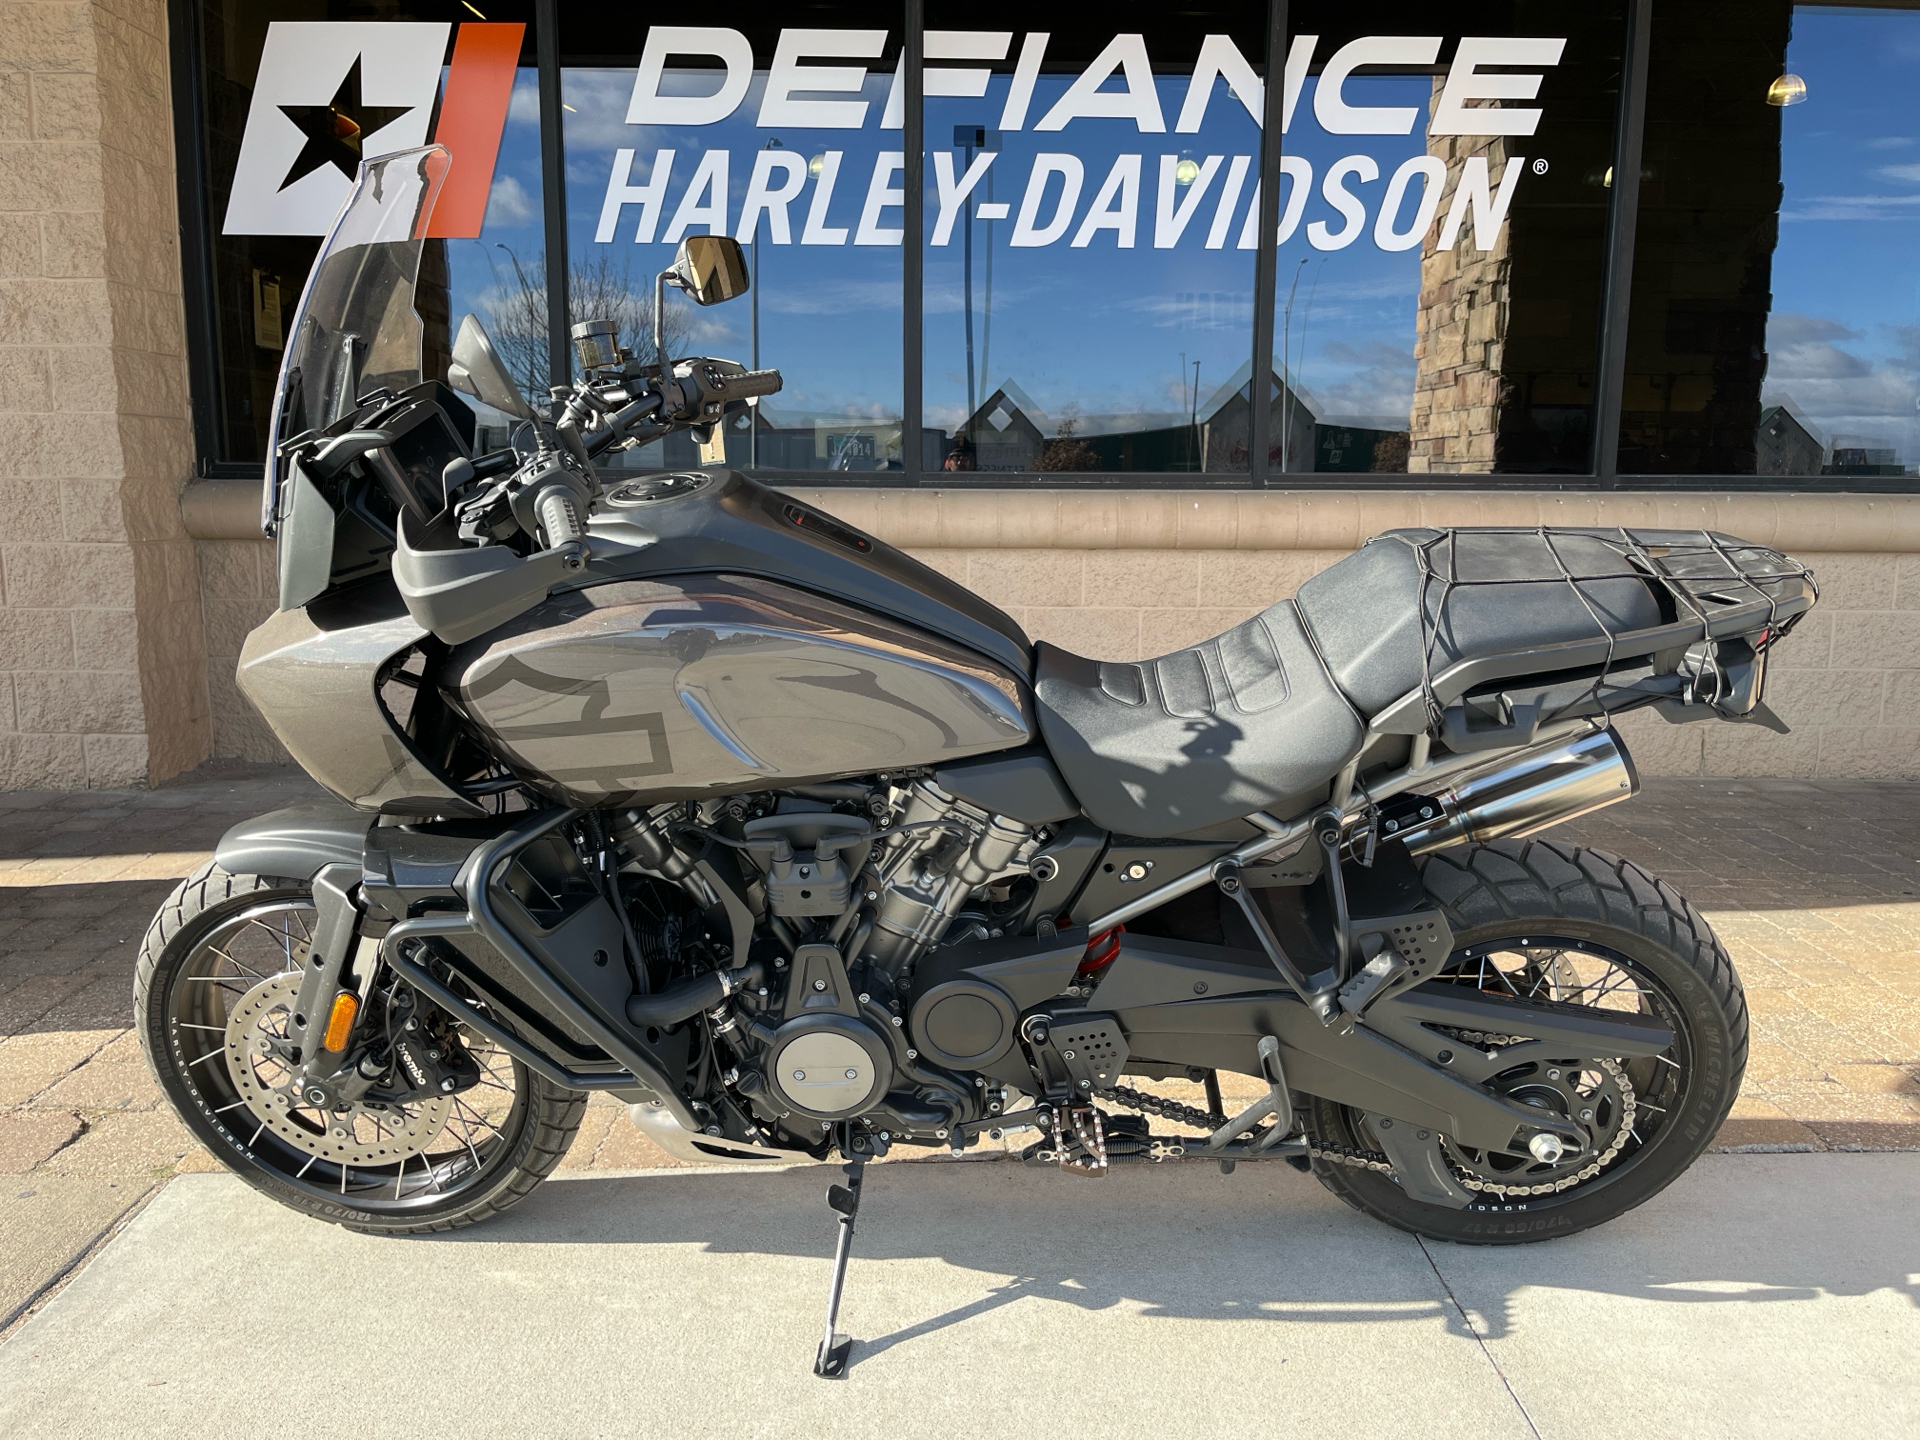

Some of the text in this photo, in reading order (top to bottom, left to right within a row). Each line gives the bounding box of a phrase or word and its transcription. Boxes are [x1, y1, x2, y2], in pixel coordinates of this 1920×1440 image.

[624, 26, 1567, 136] DEFIANCE
[150, 969, 174, 1079] HARLEY-DAVIDSON
[395, 1042, 427, 1086] brembo
[171, 1016, 255, 1160] HARLEY-DAVIDSON
[514, 1079, 540, 1165] MICHELIN
[1685, 1026, 1721, 1142] MICHELIN
[324, 1205, 372, 1222] 120/70
